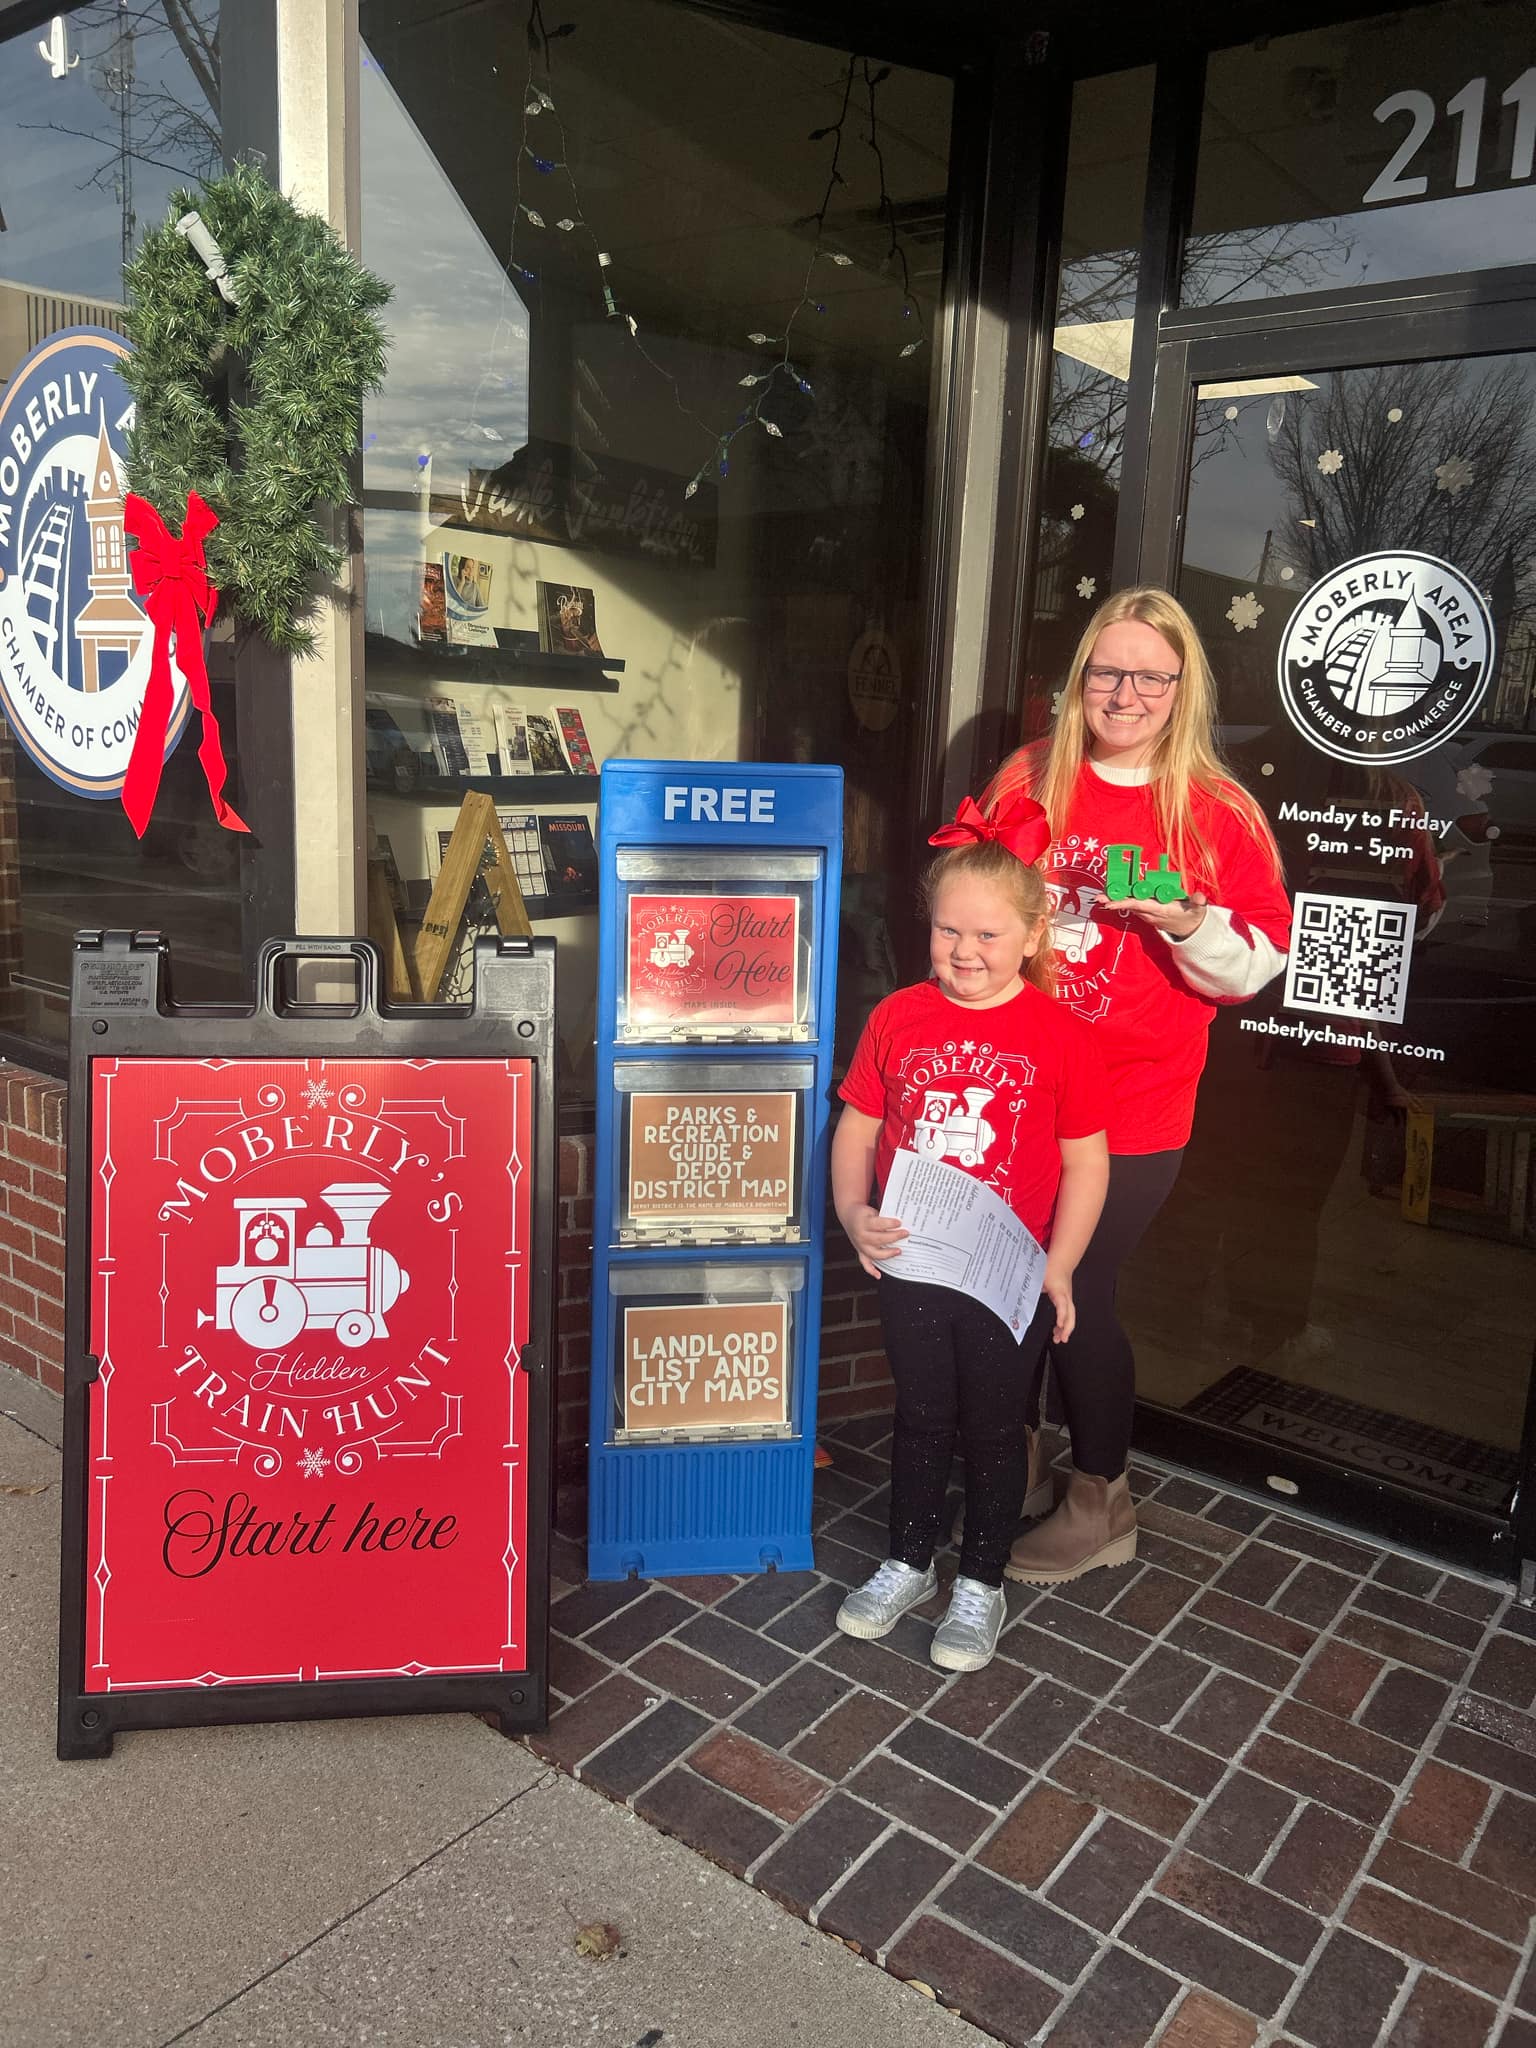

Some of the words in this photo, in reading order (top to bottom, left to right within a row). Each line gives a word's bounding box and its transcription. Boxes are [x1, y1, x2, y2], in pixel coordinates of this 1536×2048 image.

[1362, 66, 1536, 204] 211
[1300, 570, 1413, 646] MOBERLY
[1424, 585, 1474, 650] AREA
[2, 617, 66, 739] CHAMBER
[71, 725, 95, 750] OF
[1300, 678, 1352, 738] CHAMBER
[1355, 730, 1378, 743] OF
[1382, 679, 1463, 742] COMMERCE
[664, 786, 776, 824] FREE
[1278, 801, 1358, 832] Monday
[1361, 810, 1382, 827] to
[1388, 808, 1453, 838] Friday
[548, 823, 586, 832] MISSOURI
[1306, 832, 1348, 853] 9am
[1368, 838, 1414, 864] 5pm
[638, 913, 706, 941] MOBERLY'S
[710, 903, 793, 948] Start
[641, 966, 672, 989] TRAIN
[674, 966, 704, 989] HUNT
[713, 950, 792, 997] Here
[1055, 968, 1112, 999] HUNT
[710, 1001, 737, 1009] INSIDE
[1239, 1016, 1445, 1061] moberlychamber.com
[902, 1056, 1027, 1112] MOBERLY'S
[644, 1124, 779, 1144] RECREATION
[666, 1106, 737, 1125] PARKS
[746, 1108, 757, 1123] &
[157, 1114, 464, 1225] MOBERLY'S
[668, 1143, 732, 1162] GUIDE
[742, 1145, 753, 1160] &
[676, 1161, 746, 1181] DEPOT
[633, 1180, 731, 1200] DISTRICT
[741, 1179, 787, 1198] MAP
[633, 1331, 777, 1360] LANDLORD
[249, 1352, 371, 1391] Hidden
[641, 1357, 702, 1382] LIST
[713, 1354, 769, 1379] AND
[173, 1344, 310, 1439] TRAIN
[322, 1336, 452, 1436] HUNT
[630, 1382, 691, 1407] CITY
[704, 1377, 779, 1403] MAPS
[1261, 1412, 1488, 1496] WELCOME
[162, 1489, 337, 1579] Start
[342, 1501, 460, 1554] here
